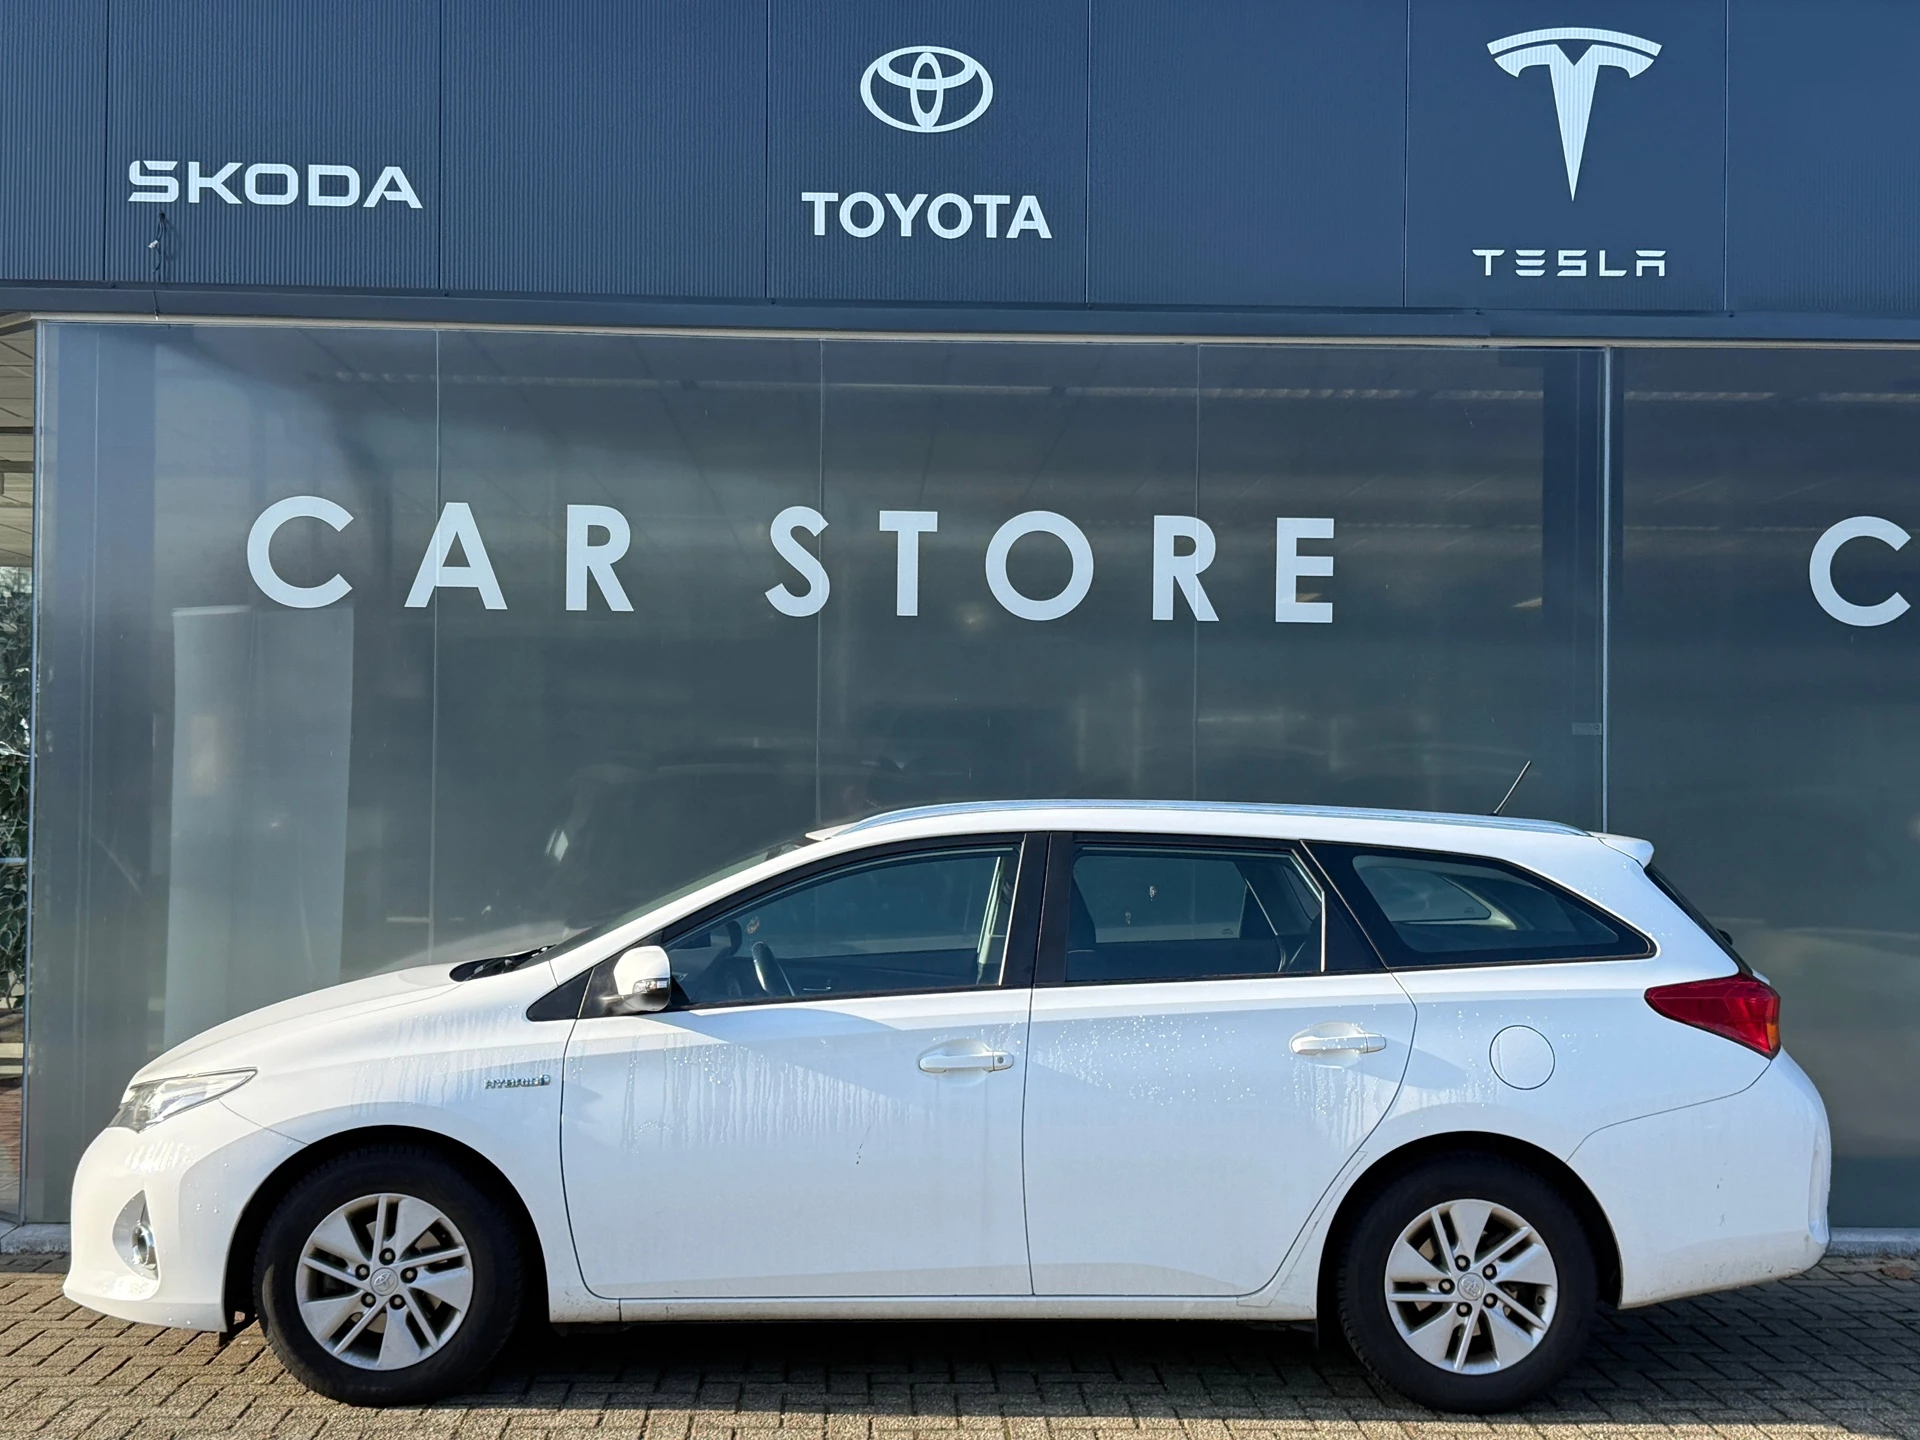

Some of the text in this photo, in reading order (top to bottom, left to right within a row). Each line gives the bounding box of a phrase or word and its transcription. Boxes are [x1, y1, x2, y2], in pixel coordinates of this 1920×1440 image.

[128, 160, 423, 209] SKODA
[801, 191, 1053, 239] TOYOTA
[1472, 249, 1667, 277] TESLA
[247, 495, 1335, 624] CAR STORE
[1809, 516, 1911, 627] C
